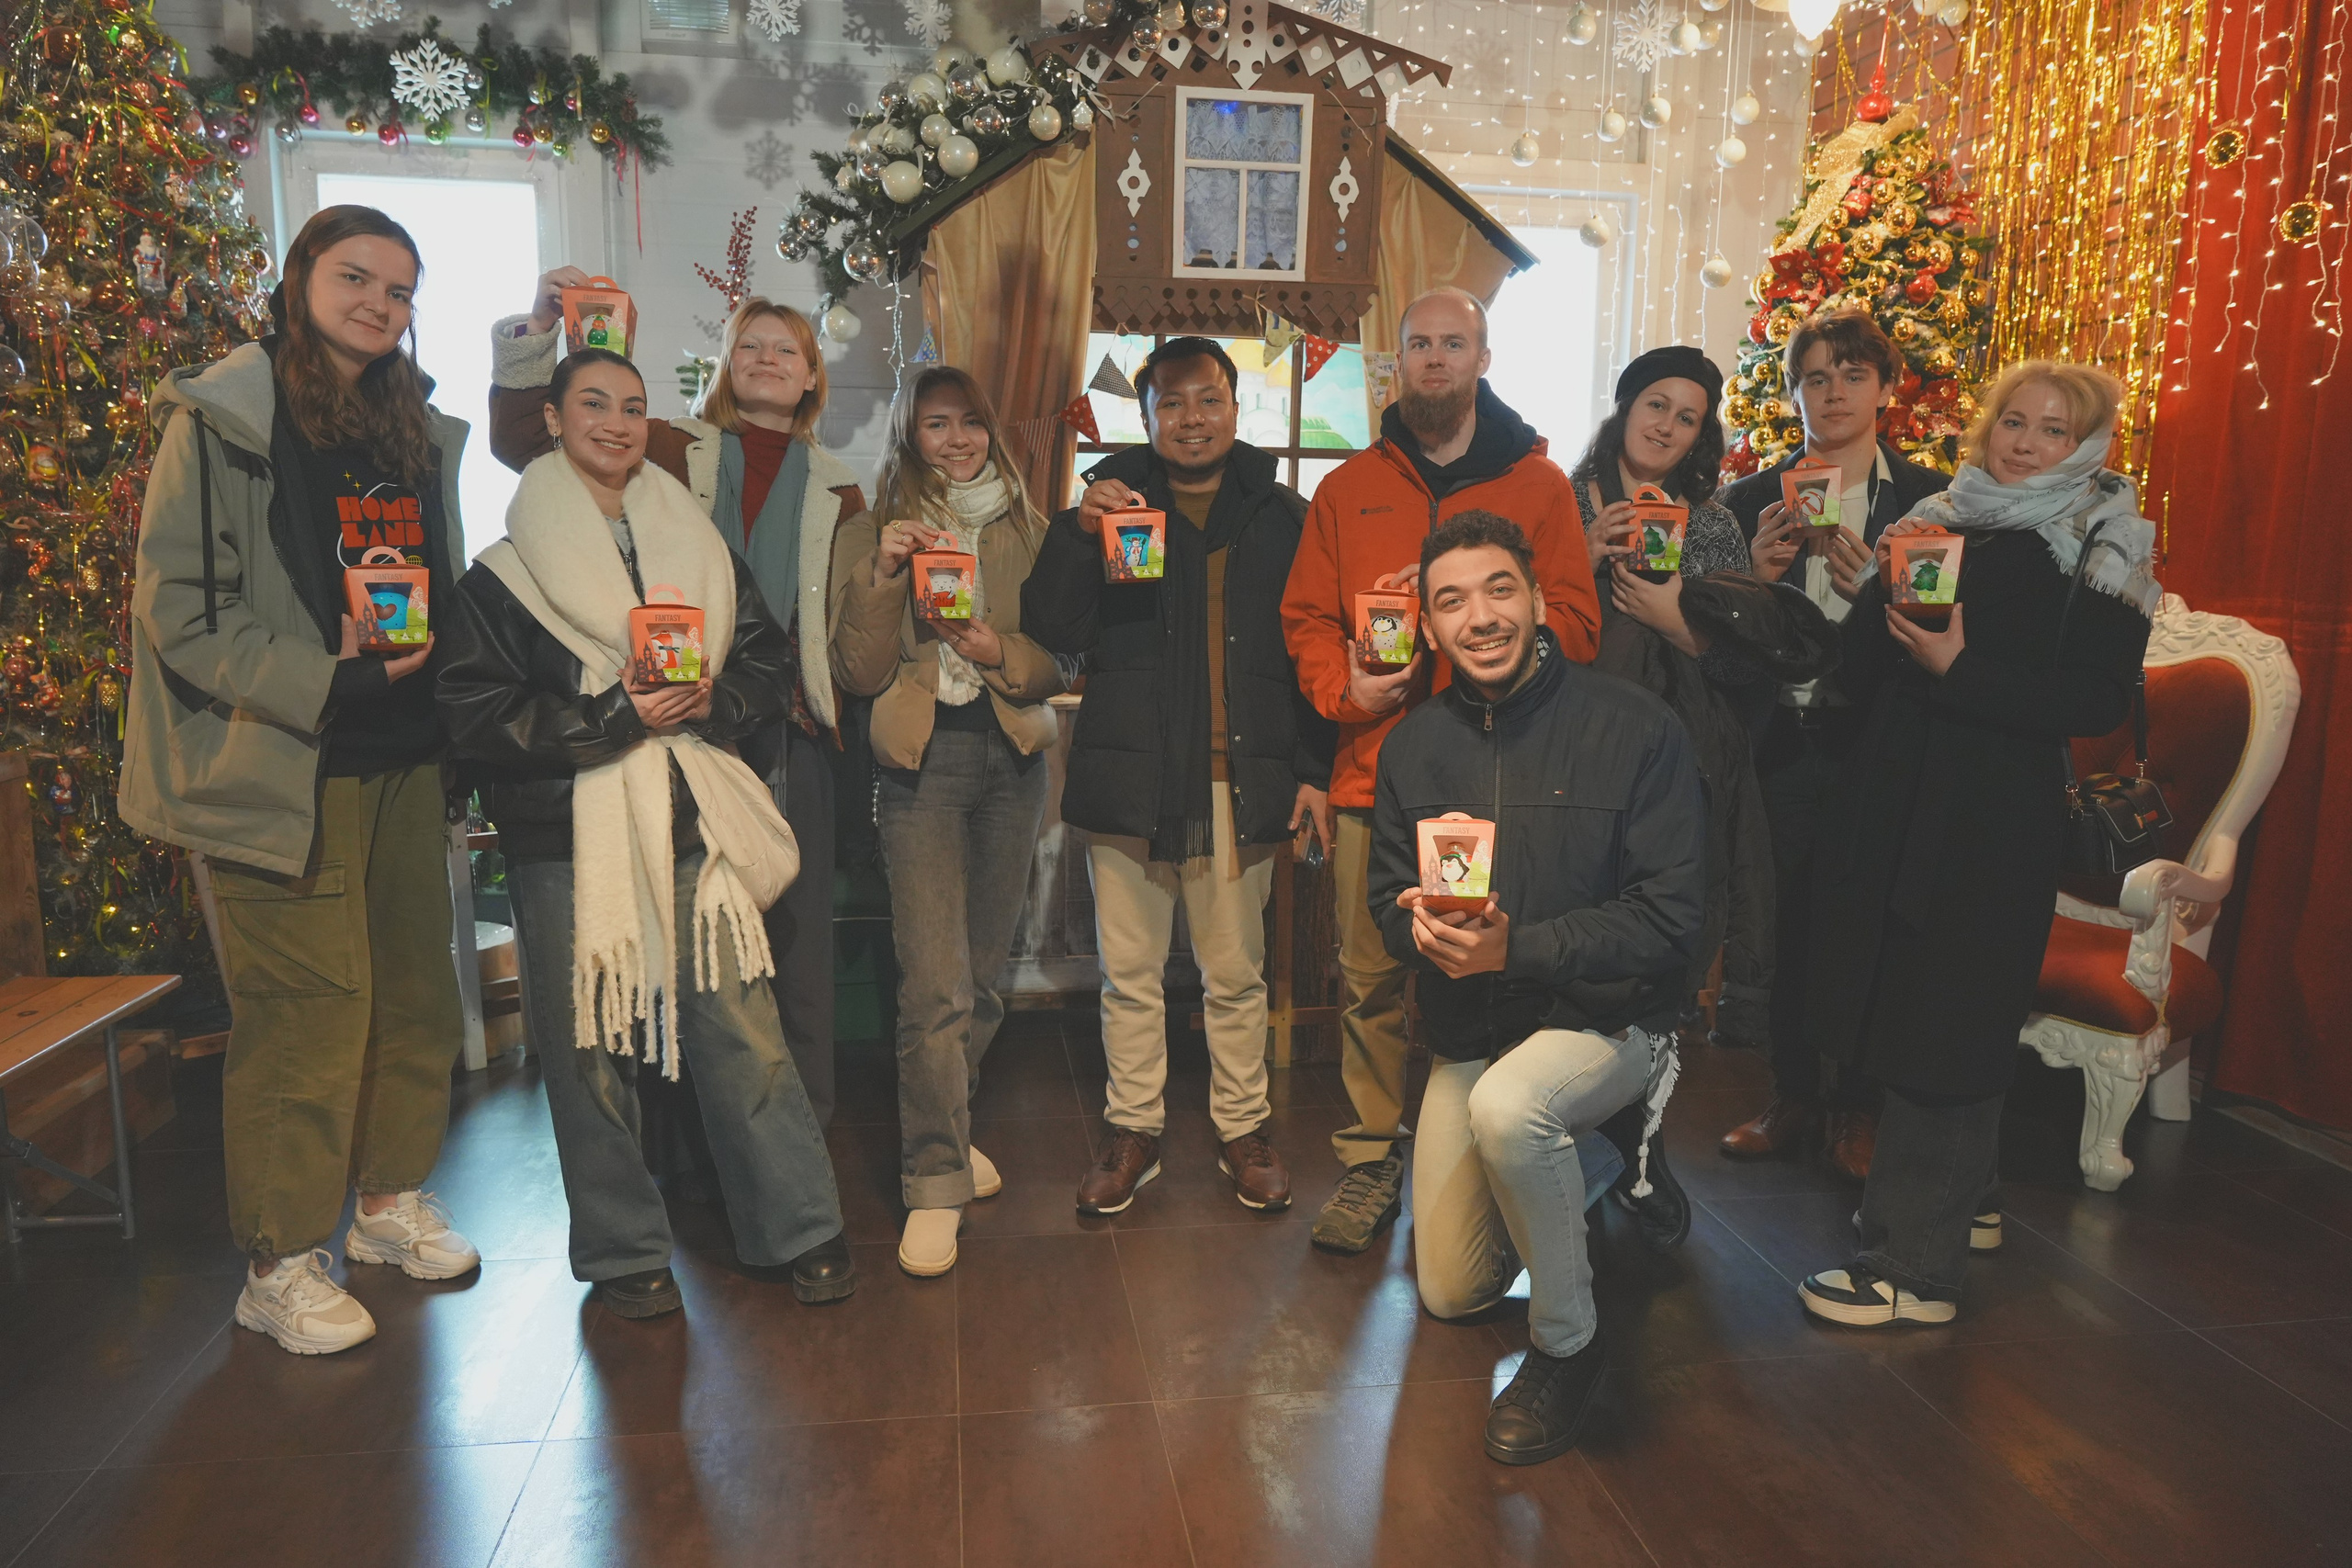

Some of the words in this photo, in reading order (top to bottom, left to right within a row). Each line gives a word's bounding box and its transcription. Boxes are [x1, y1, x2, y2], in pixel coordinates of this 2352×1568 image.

[335, 496, 422, 522] HOME
[1123, 516, 1147, 525] FANTASY
[341, 522, 424, 548] LAND
[933, 558, 956, 567] FANTASY
[374, 573, 403, 581] FANTASY
[1375, 599, 1399, 608] FANTASY
[654, 614, 682, 622] FANTASY
[1442, 827, 1470, 835] FANTASY
